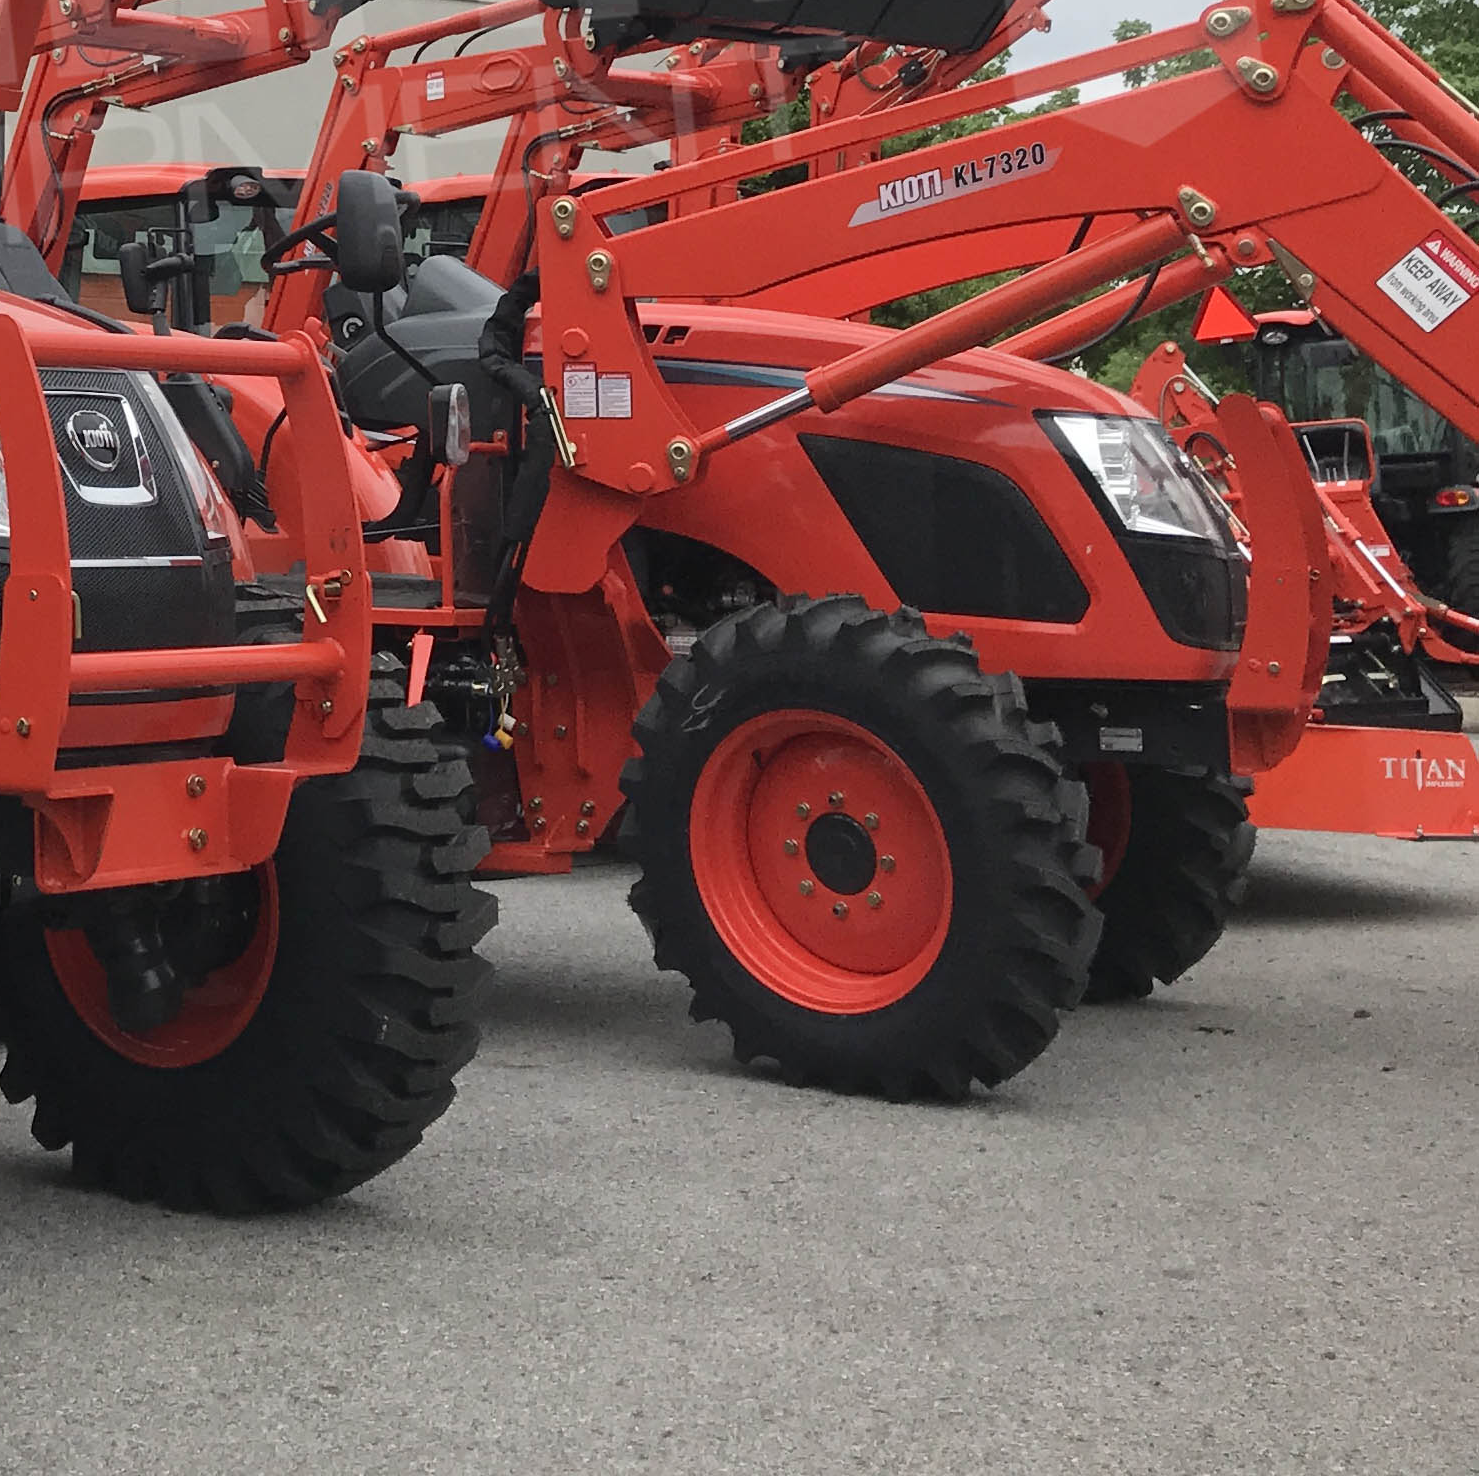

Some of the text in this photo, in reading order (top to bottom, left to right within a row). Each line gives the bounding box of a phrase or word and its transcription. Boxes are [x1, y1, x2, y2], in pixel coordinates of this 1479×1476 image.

[878, 141, 1046, 212] KIOTI KL7320
[1401, 254, 1462, 308] KEEP AWAY
[1440, 247, 1479, 289] WARNING
[1386, 272, 1439, 324] from working area
[82, 426, 116, 449] KIOTI
[1379, 756, 1466, 791] TITAN
